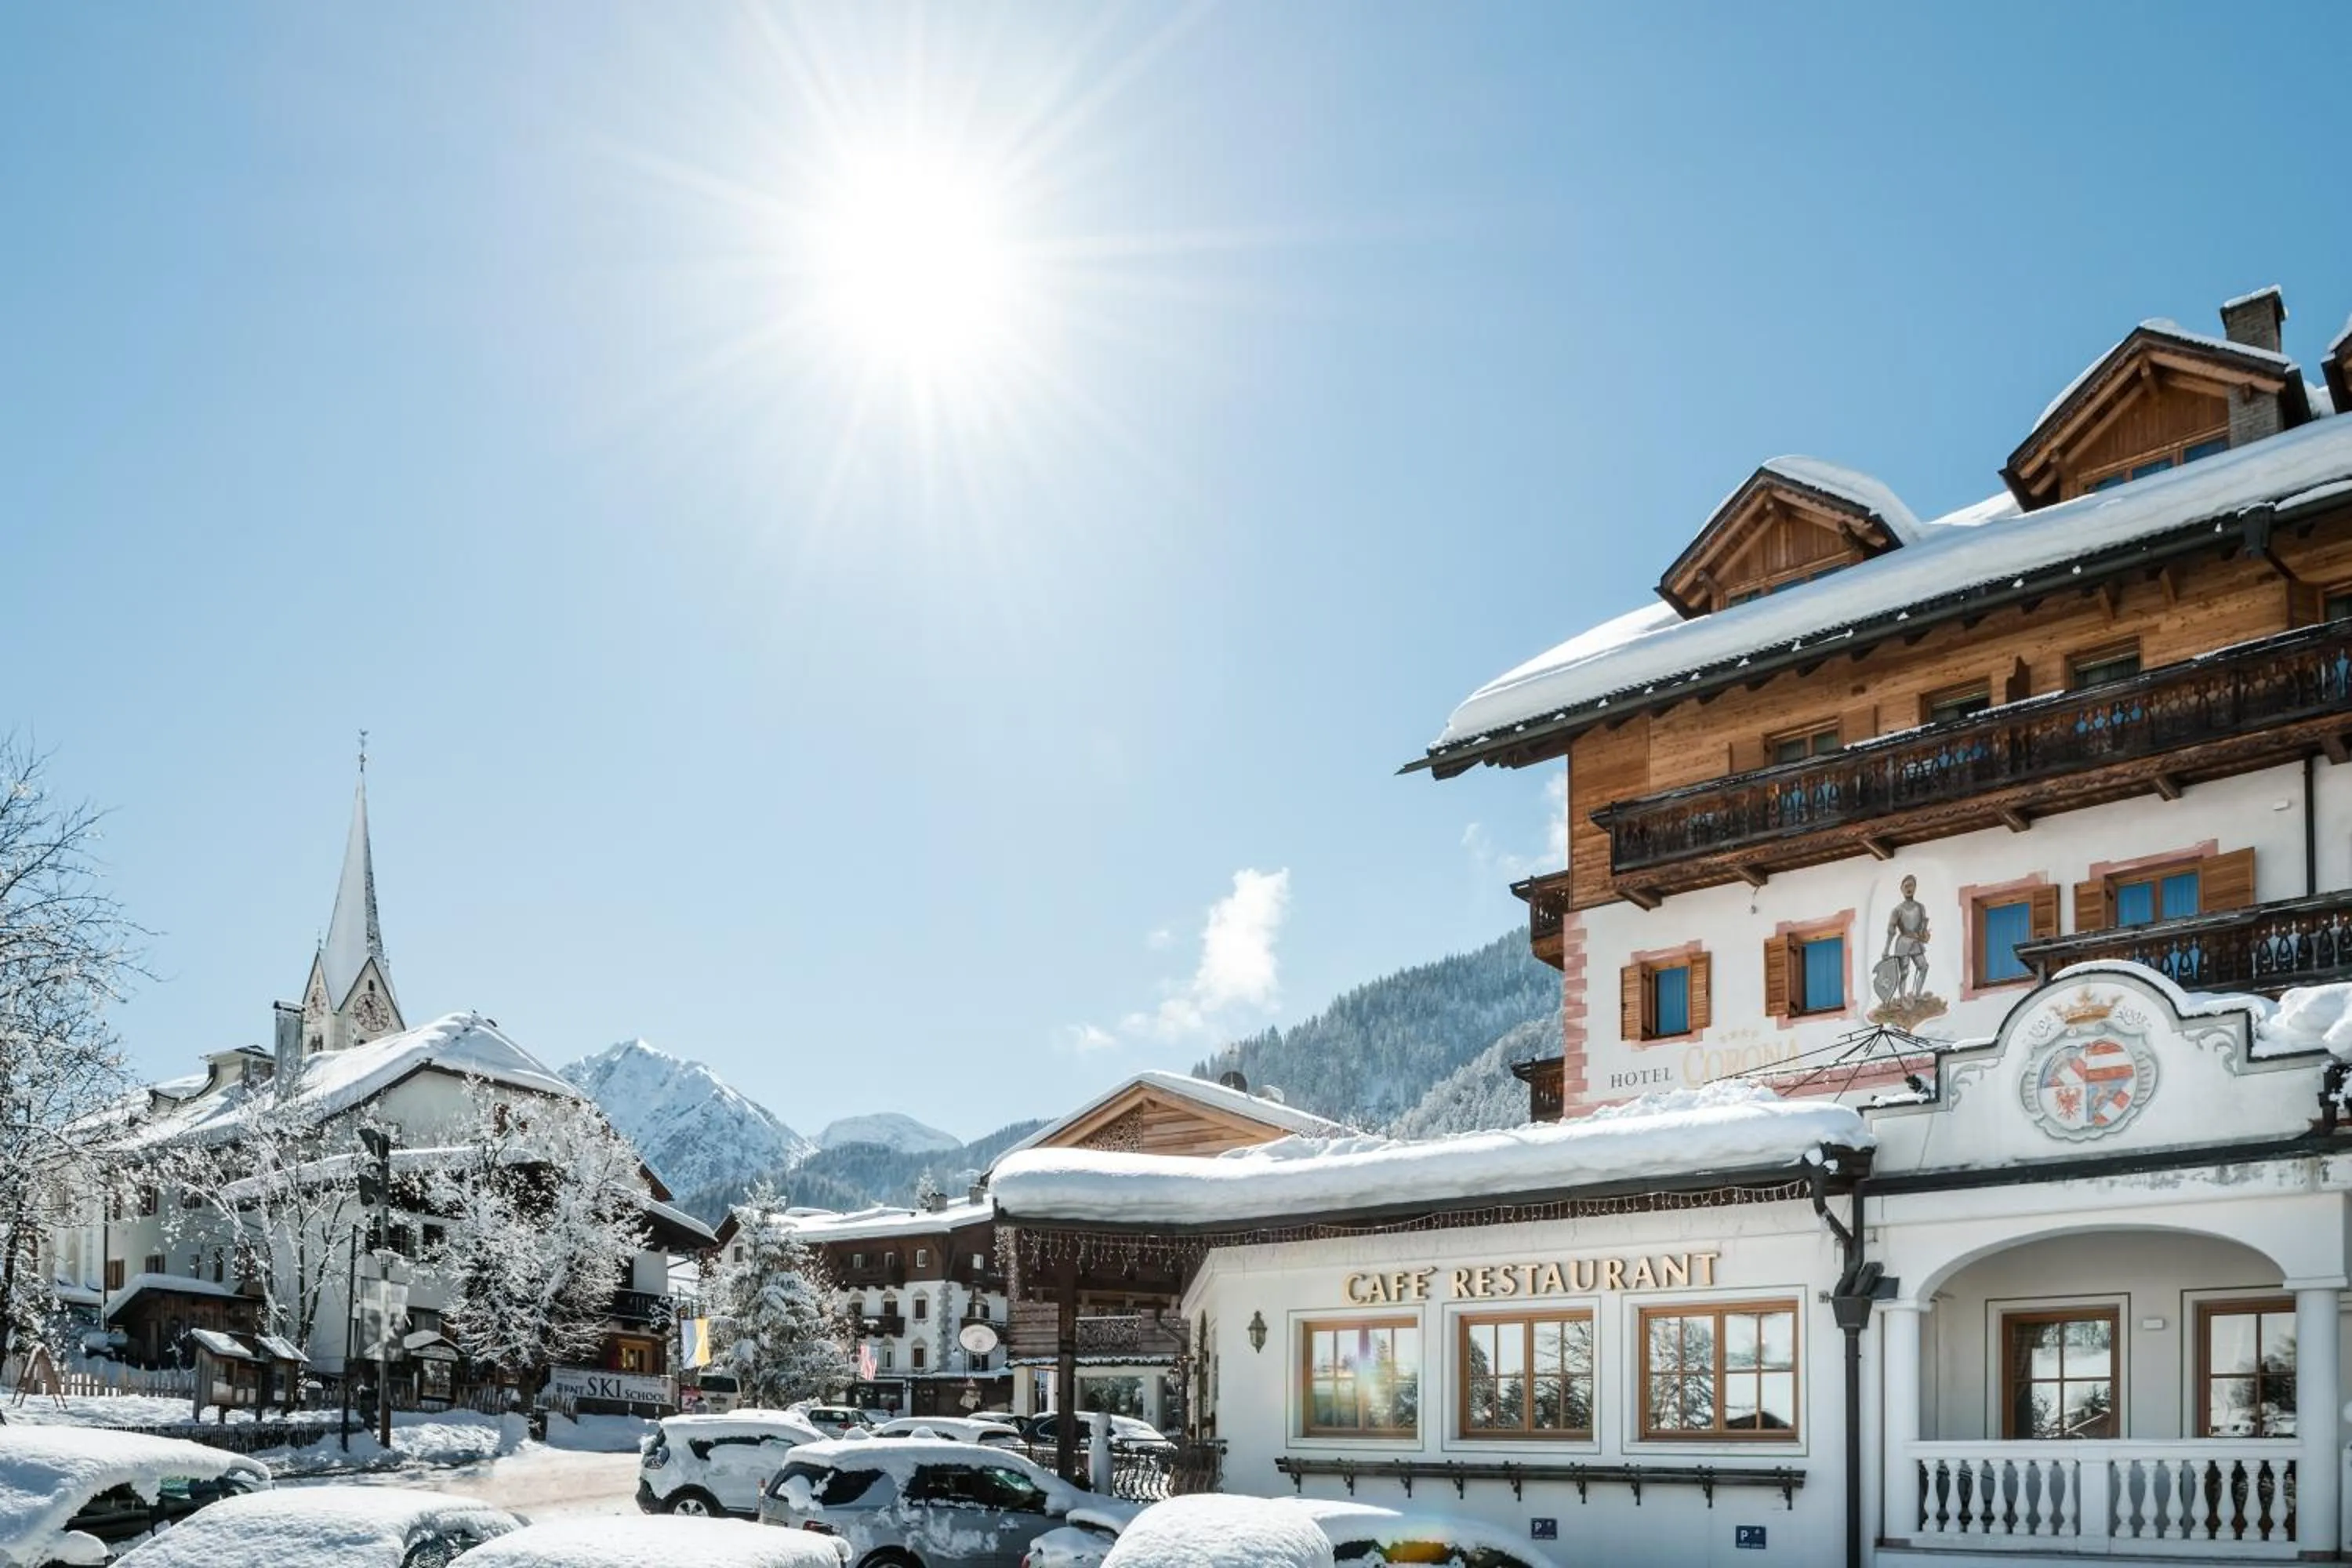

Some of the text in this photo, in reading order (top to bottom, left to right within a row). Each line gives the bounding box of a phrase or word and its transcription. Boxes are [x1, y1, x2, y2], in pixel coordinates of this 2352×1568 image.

[1610, 1067, 1673, 1088] HOTEL
[1450, 1252, 1721, 1298] RESTAURANT
[587, 1376, 622, 1398] SKI
[624, 1389, 666, 1403] SCHOOL
[1534, 1522, 1542, 1533] P
[1740, 1530, 1748, 1541] P
